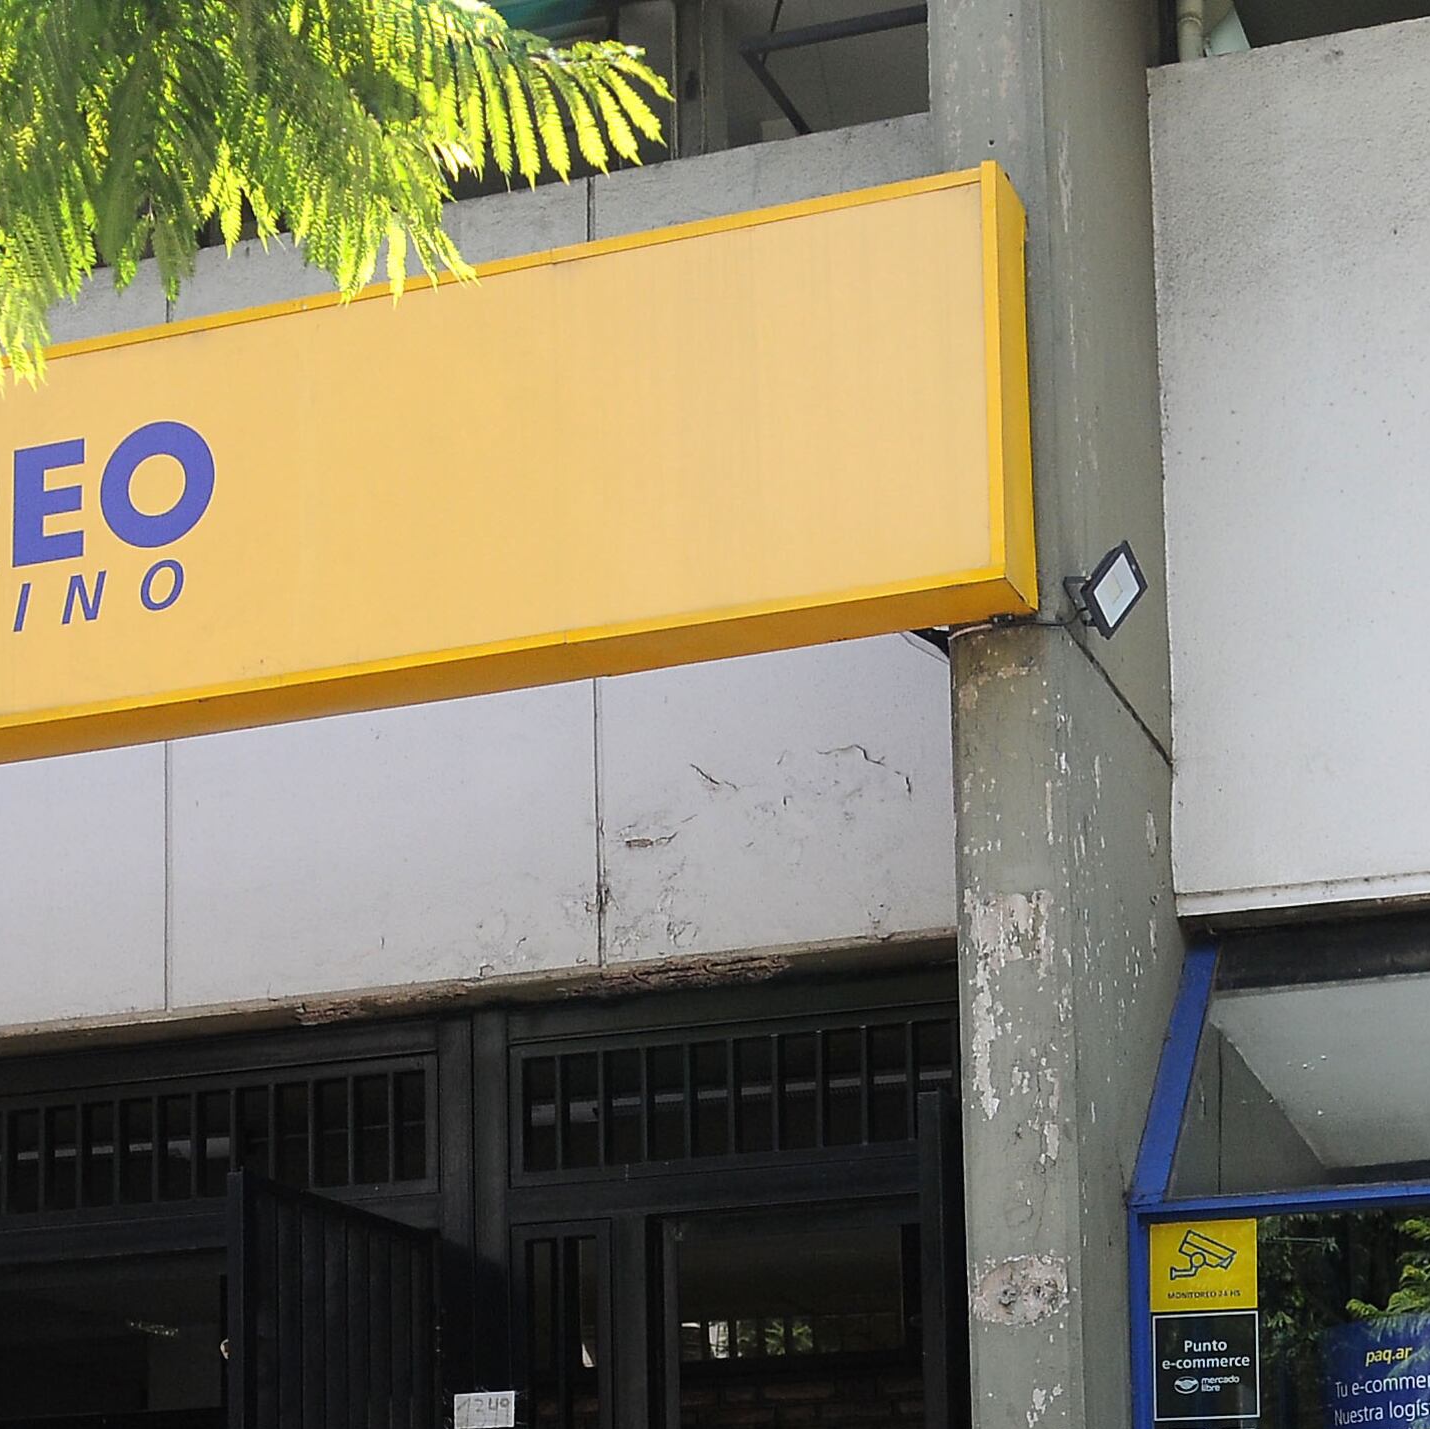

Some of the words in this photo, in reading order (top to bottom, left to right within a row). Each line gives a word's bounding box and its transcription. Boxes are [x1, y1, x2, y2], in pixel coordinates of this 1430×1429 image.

[1184, 1340, 1228, 1353] Punto
[1162, 1356, 1251, 1370] e-commerce
[1365, 1346, 1413, 1367] paq.ar
[1201, 1375, 1240, 1384] mercado
[1201, 1384, 1221, 1392] libre
[1335, 1381, 1348, 1398] Tu
[1334, 1405, 1384, 1427] Nuestra
